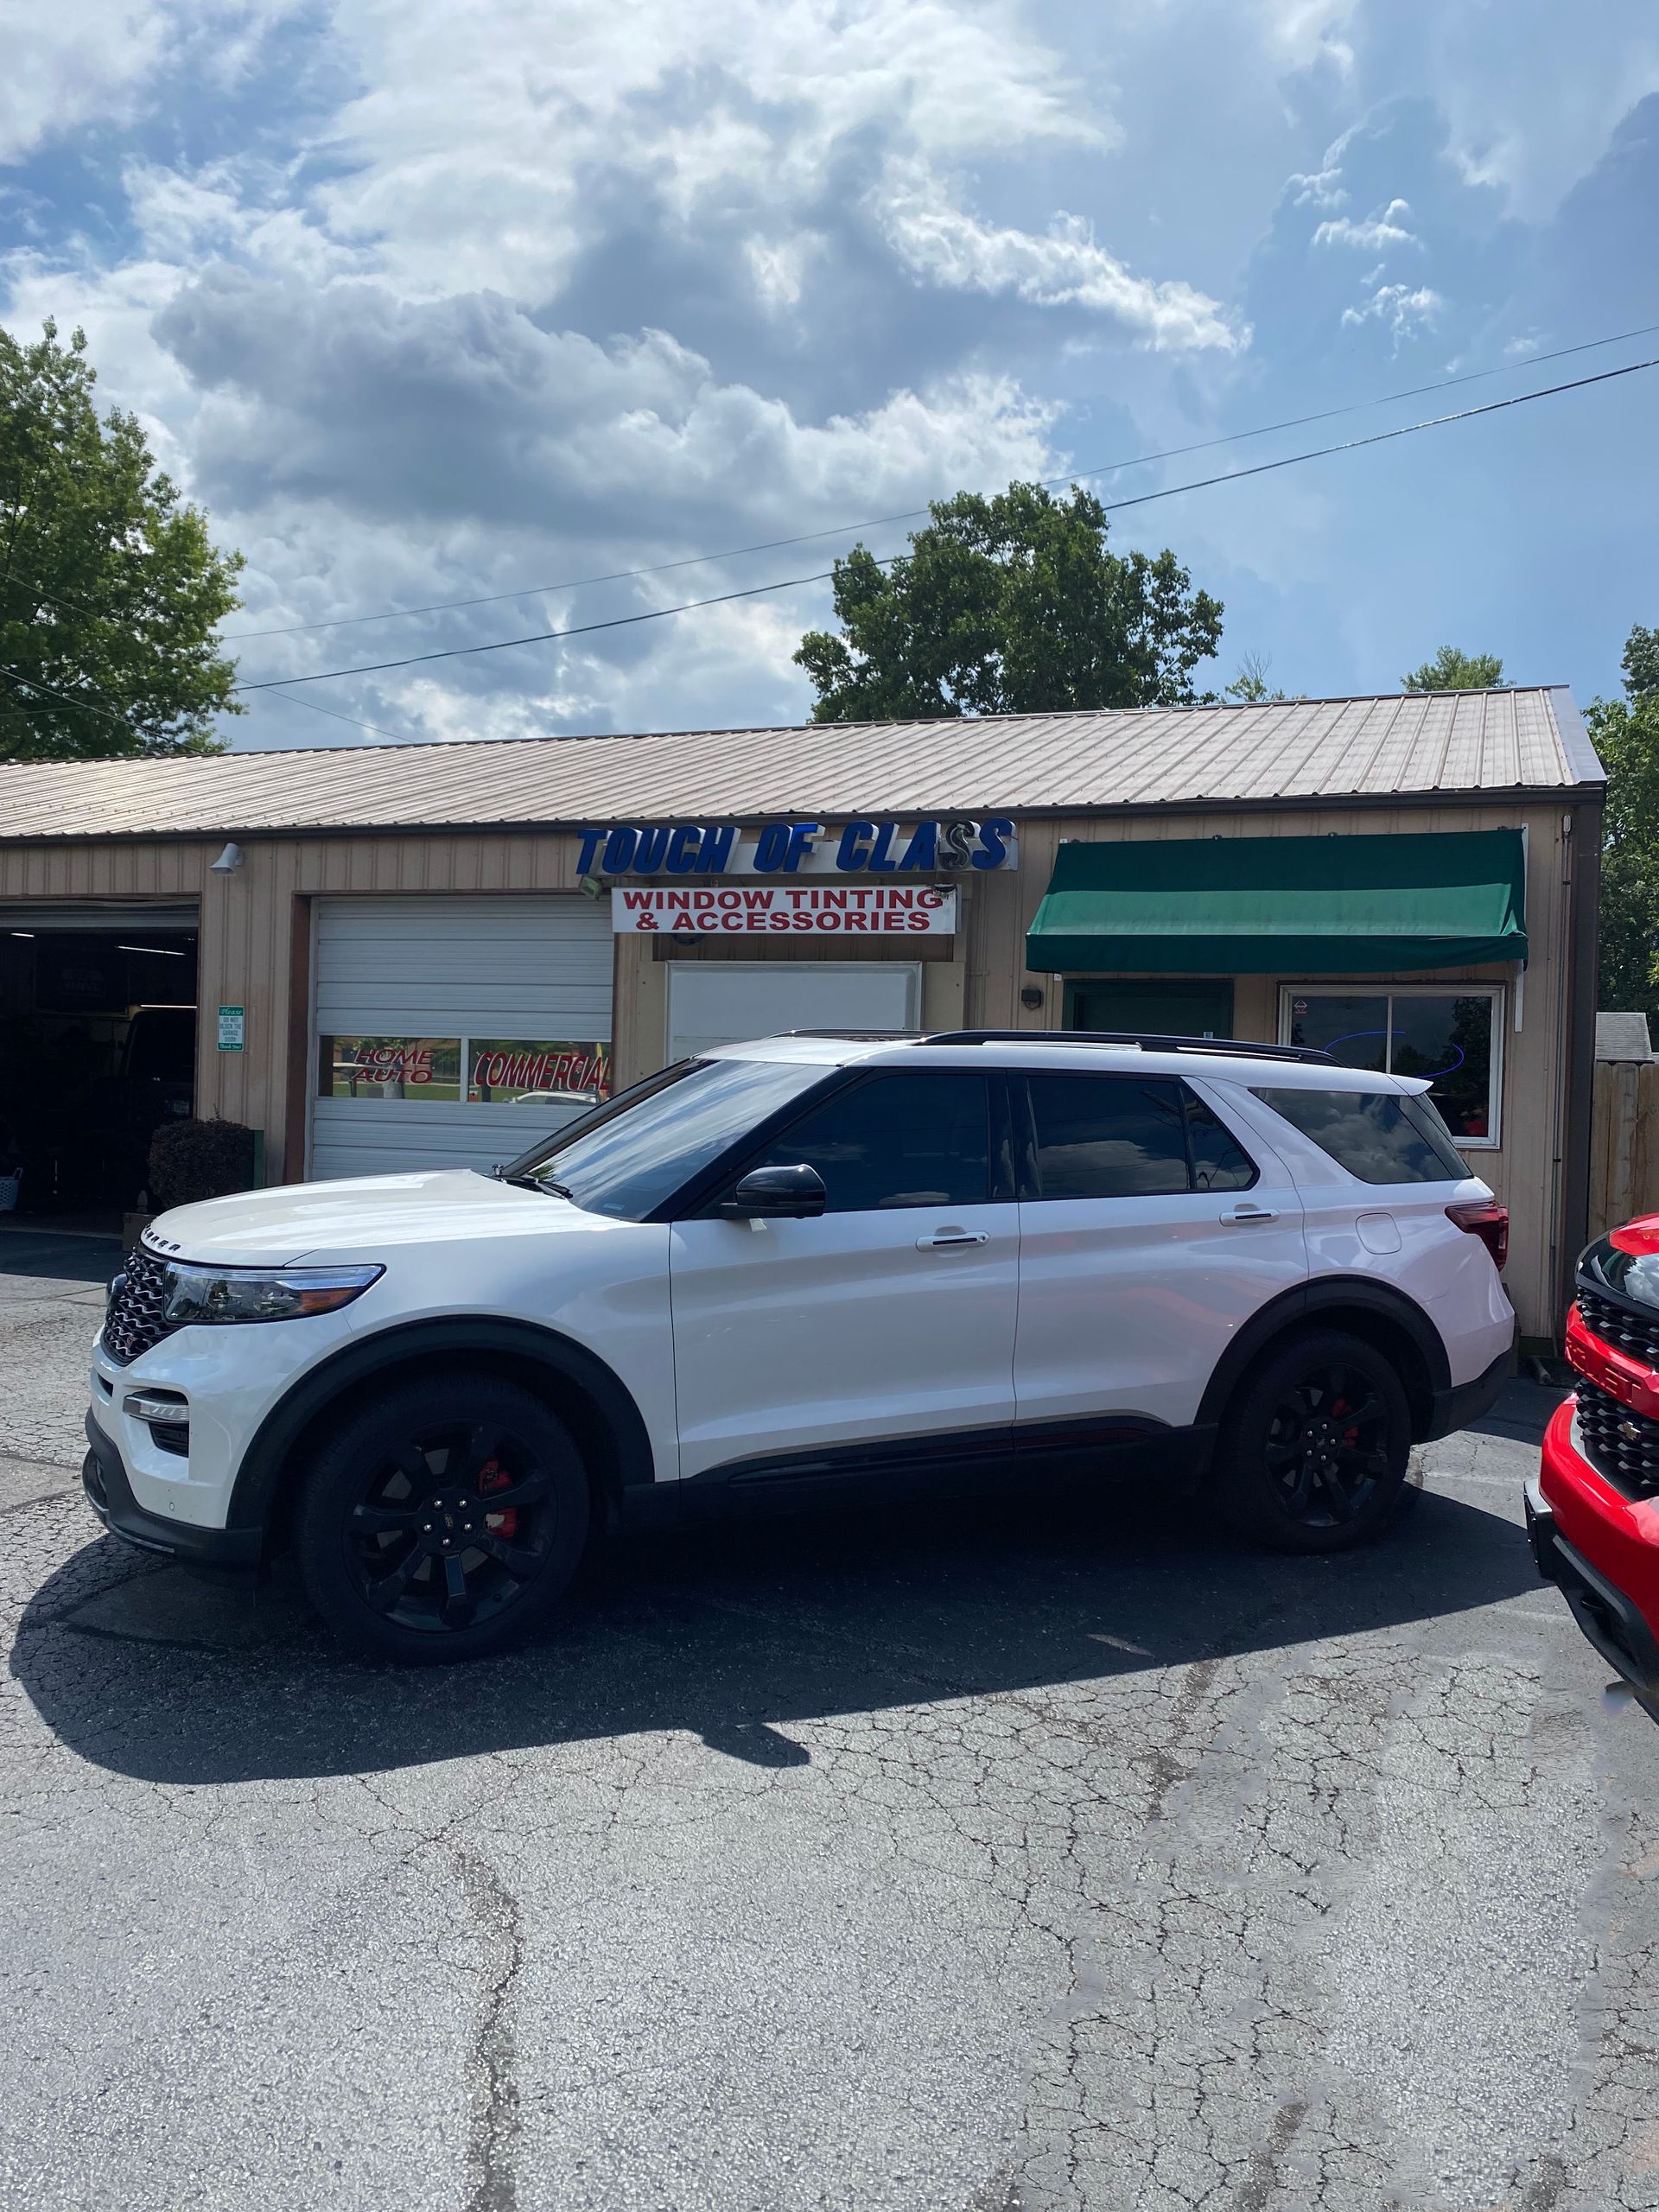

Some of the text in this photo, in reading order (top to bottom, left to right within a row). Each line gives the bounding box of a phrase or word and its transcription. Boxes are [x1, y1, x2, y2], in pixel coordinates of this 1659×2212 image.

[575, 817, 1015, 875] TOUCH OF CLASS
[622, 888, 944, 910] WINDOW TINTING
[635, 911, 931, 931] & ACCESSORIES
[353, 1047, 435, 1065] HOME
[351, 1067, 433, 1084] AUTO
[474, 1051, 610, 1090] COMMERCIAL
